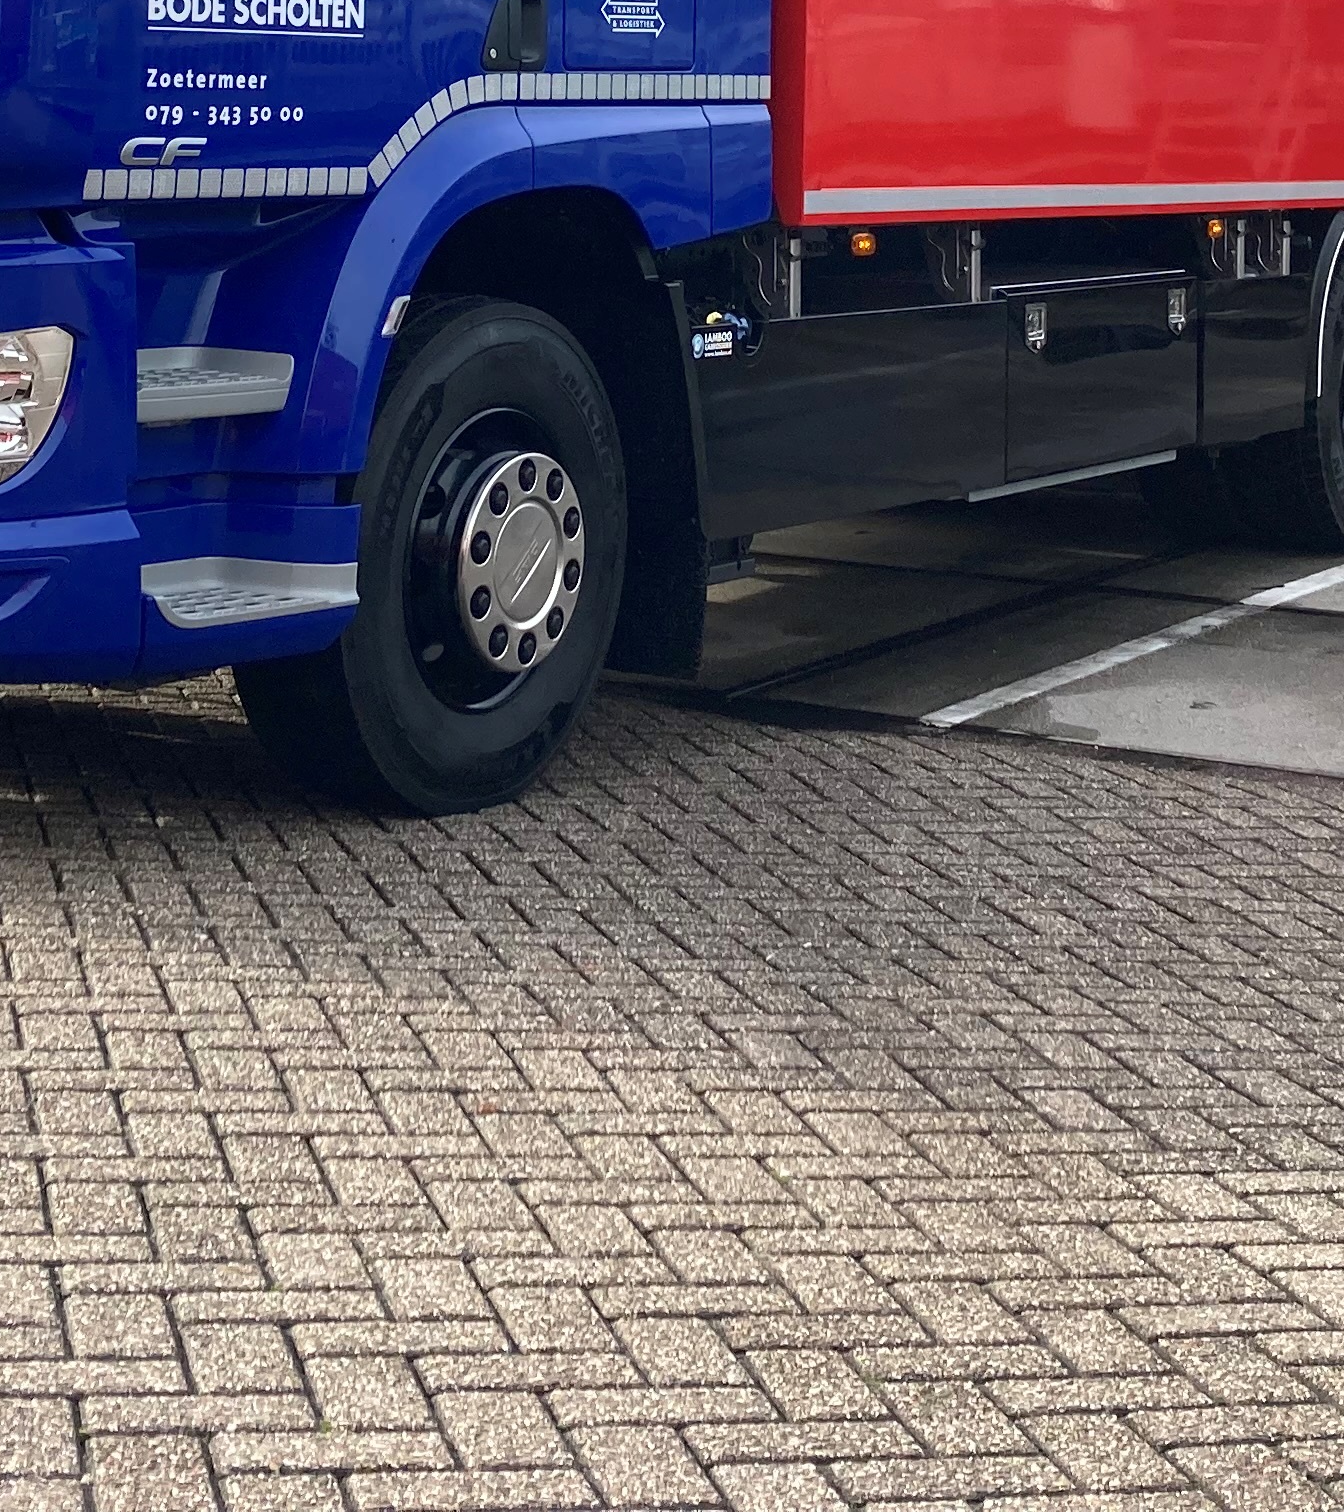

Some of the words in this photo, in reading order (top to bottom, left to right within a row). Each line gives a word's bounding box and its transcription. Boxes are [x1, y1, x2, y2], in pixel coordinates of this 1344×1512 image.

[612, 5, 655, 15] TRANSPORT
[619, 19, 655, 28] LOGISTIEK
[146, 68, 267, 89] Zoetermeer
[145, 105, 184, 125] 079
[207, 105, 241, 126] 343
[249, 106, 272, 126] 50
[279, 106, 304, 122] 00
[119, 136, 208, 167] CF
